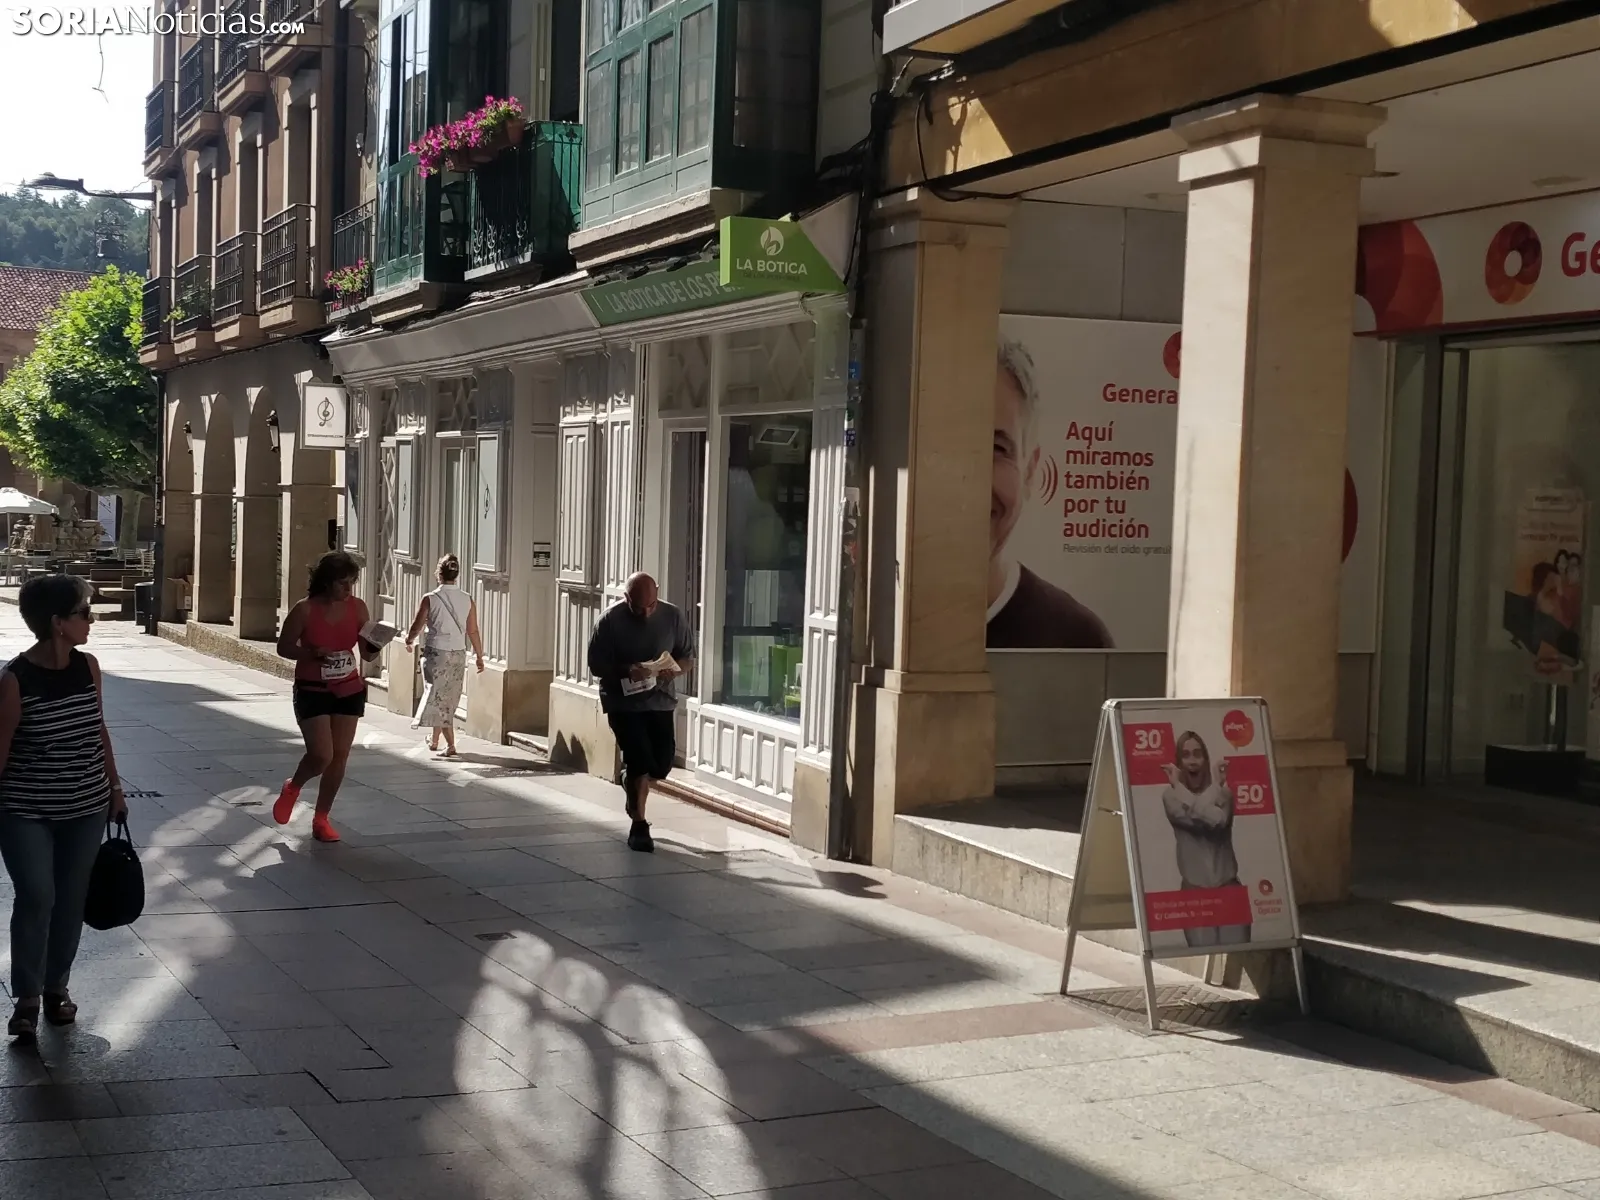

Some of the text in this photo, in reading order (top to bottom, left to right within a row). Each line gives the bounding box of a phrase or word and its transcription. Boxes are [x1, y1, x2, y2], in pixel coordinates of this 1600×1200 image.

[1561, 231, 1600, 278] Ge
[736, 258, 808, 275] LA BOTICA
[605, 293, 627, 313] LA
[620, 285, 669, 311] BOTICA
[661, 281, 687, 303] DE
[679, 275, 712, 300] LOS
[1102, 383, 1178, 405] Genera
[1065, 421, 1114, 447] Aquí
[1066, 447, 1154, 467] miramos
[1064, 470, 1150, 491] también
[1064, 496, 1126, 518] por tu
[1063, 518, 1149, 539] audición
[329, 657, 352, 669] 274
